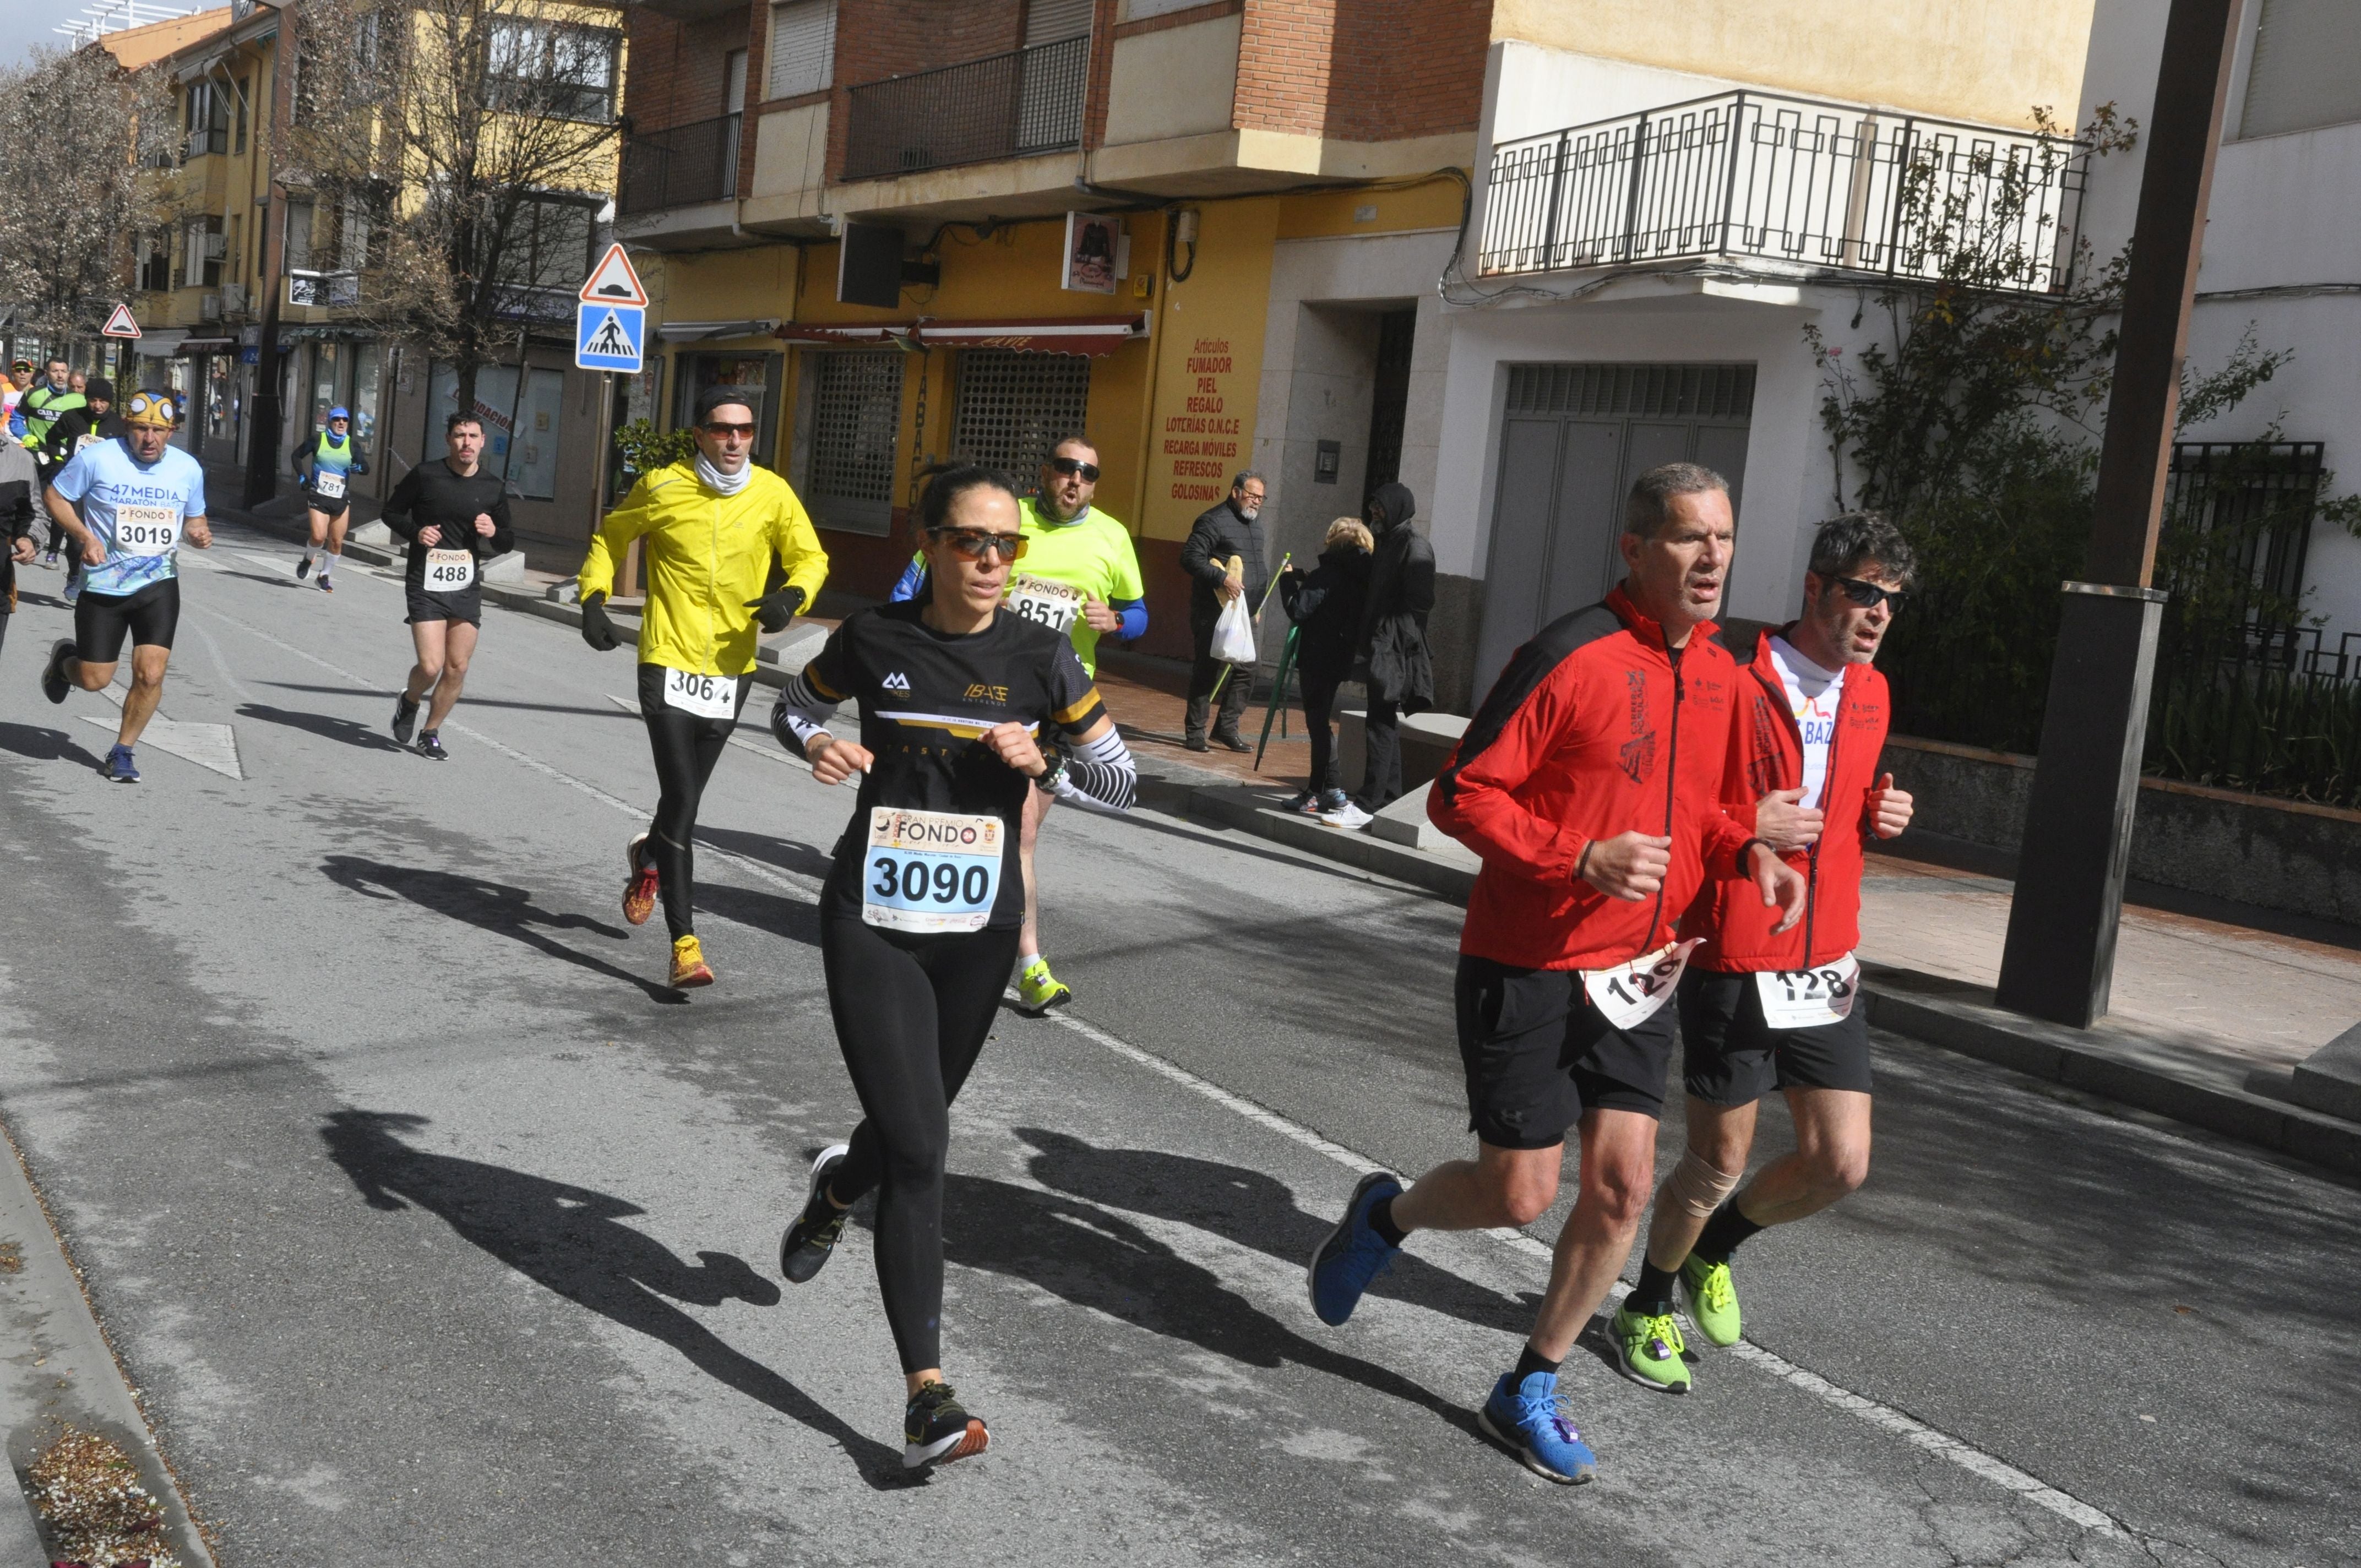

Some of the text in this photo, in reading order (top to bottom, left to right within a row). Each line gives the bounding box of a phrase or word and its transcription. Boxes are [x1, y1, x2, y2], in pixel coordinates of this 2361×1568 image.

[1194, 337, 1229, 354] Artículos
[1187, 357, 1232, 373] FUMADOR
[1196, 377, 1217, 394] PIEL
[1187, 397, 1223, 413] REGALO
[1166, 415, 1206, 434] LOTERÍAS
[1163, 438, 1237, 458] RECARGA MÓVILES
[1173, 460, 1223, 478] REFRESCOS
[323, 481, 340, 492] 781
[110, 496, 157, 507] MARATÓN
[130, 510, 165, 520] FONDO
[121, 525, 172, 545] 3019
[433, 566, 466, 582] 488
[1028, 582, 1069, 598] FONDO
[1018, 598, 1064, 629] 851
[901, 814, 926, 824] GRAN
[929, 817, 964, 827] PREMIO
[897, 821, 977, 844] FONDO
[872, 857, 989, 905] 3090
[1776, 970, 1851, 1001] 128
